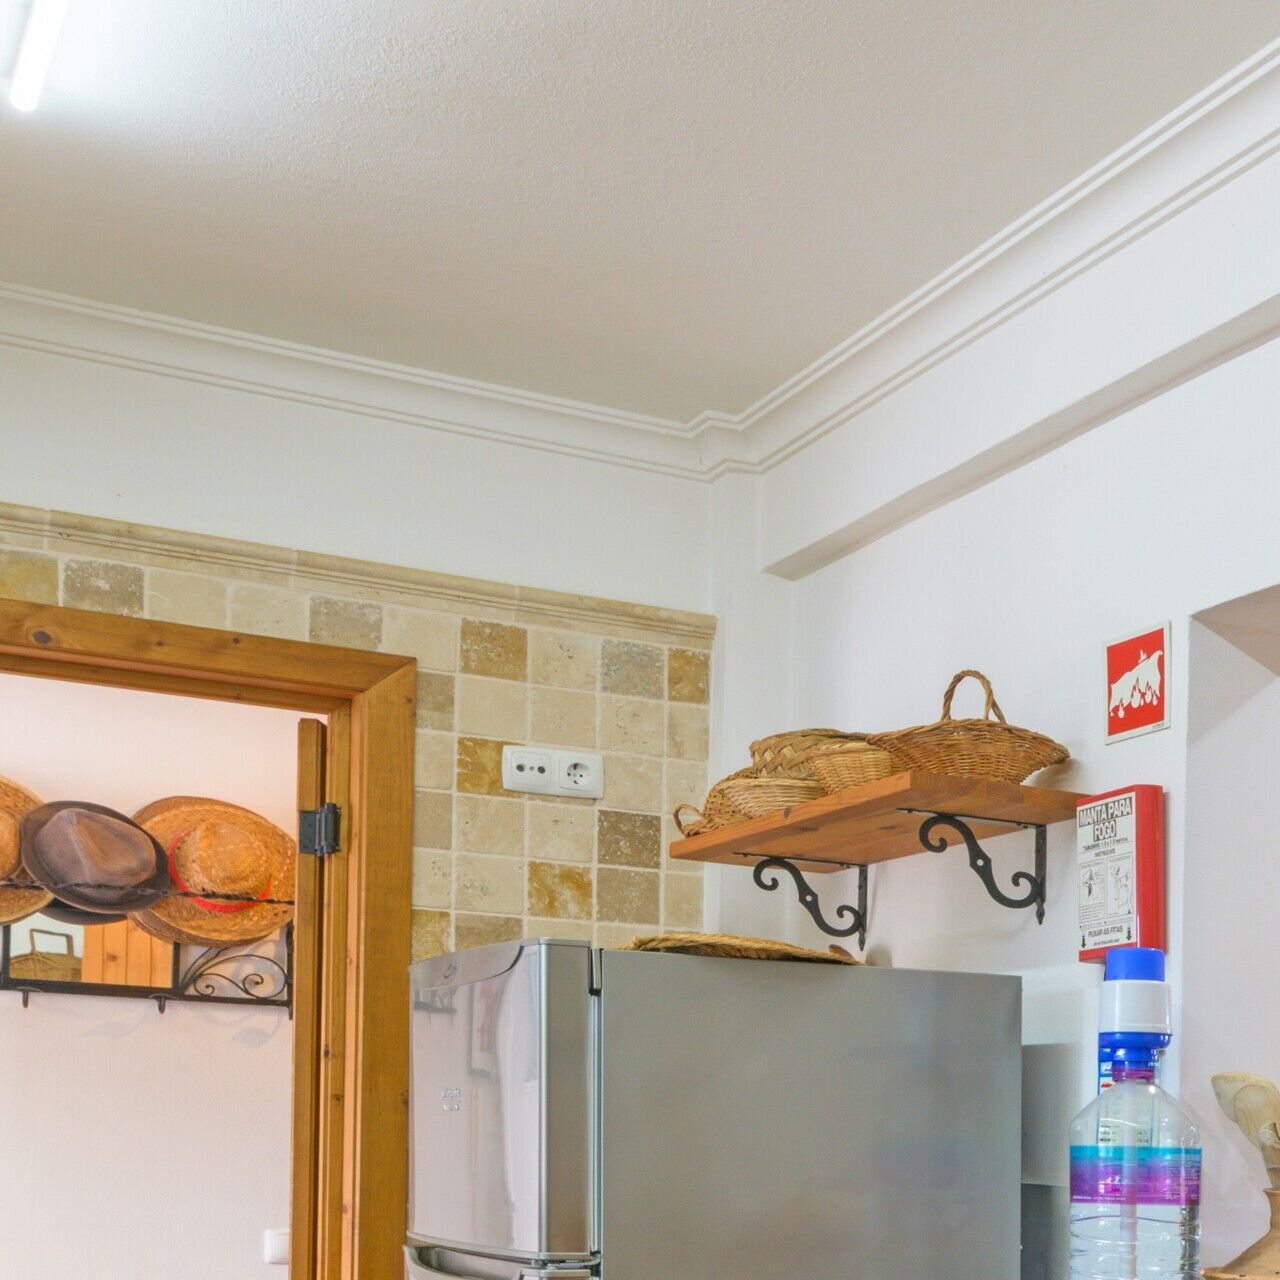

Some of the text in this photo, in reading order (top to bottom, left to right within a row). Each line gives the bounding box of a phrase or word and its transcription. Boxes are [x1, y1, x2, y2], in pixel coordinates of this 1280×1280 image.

[1080, 798, 1131, 828] MANTA PARA
[1094, 820, 1116, 841] FOGO
